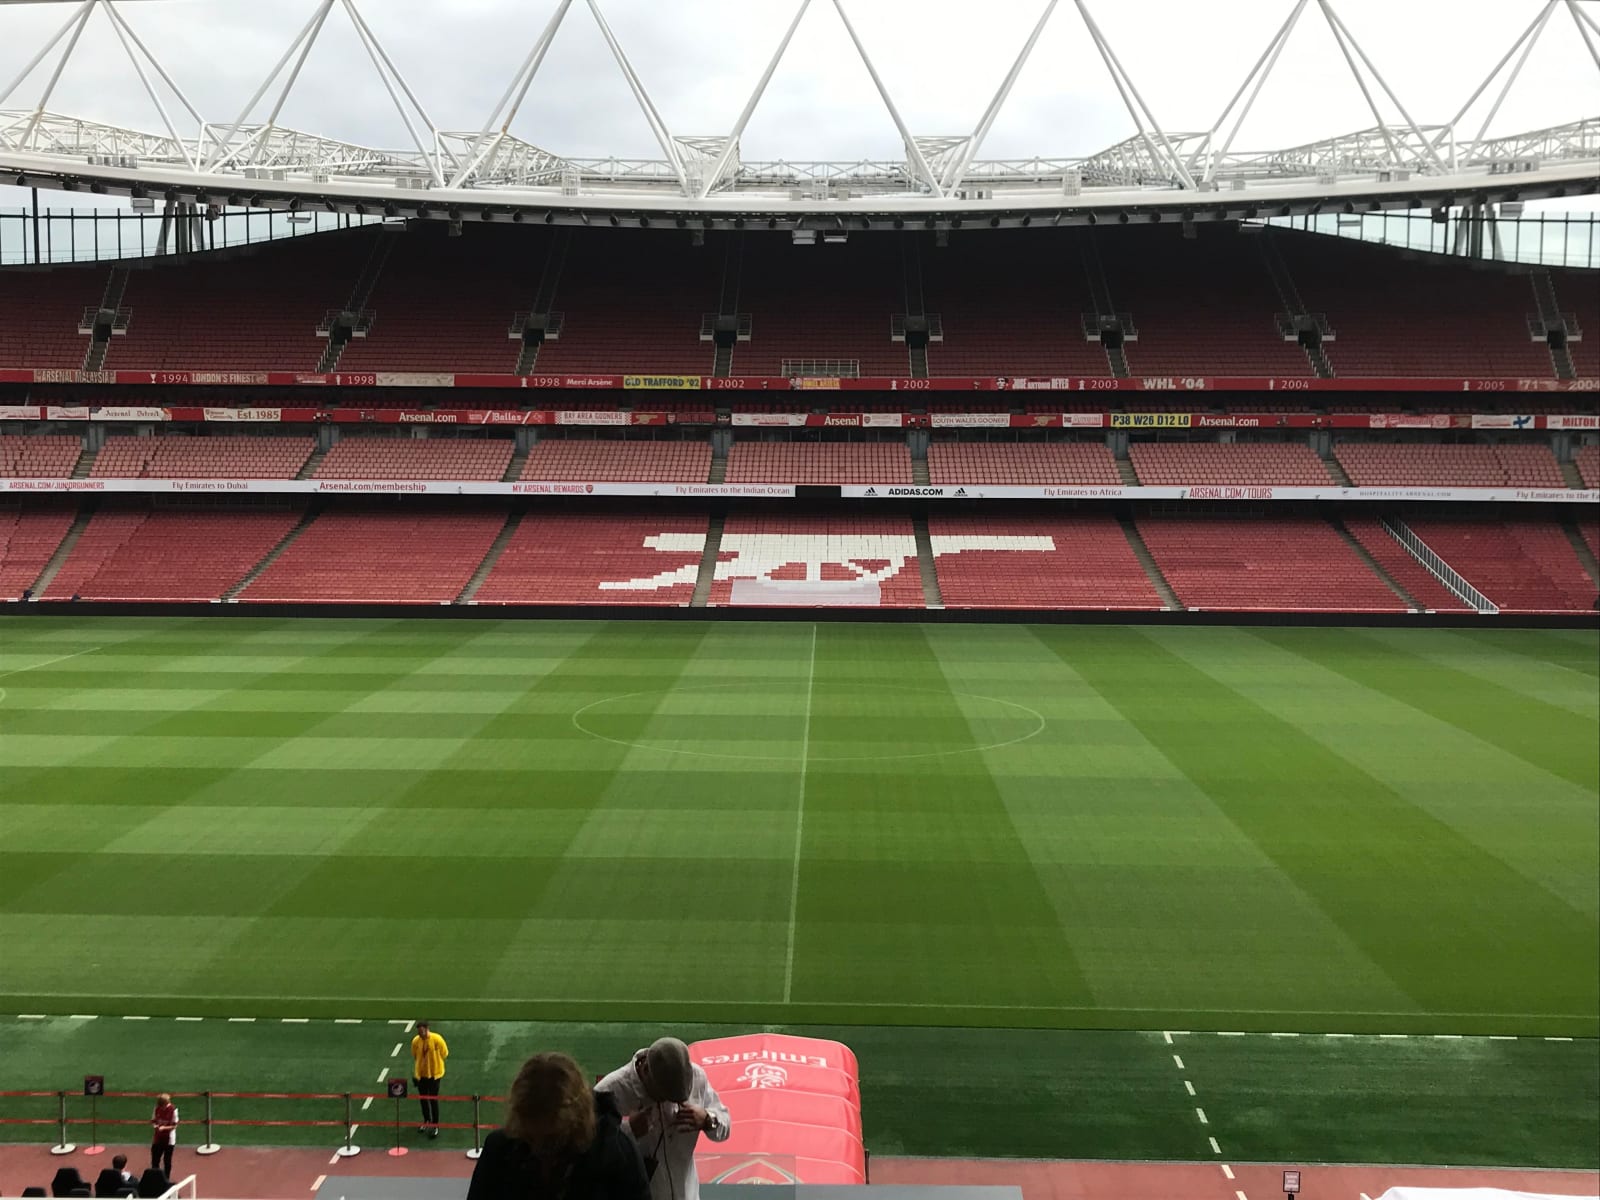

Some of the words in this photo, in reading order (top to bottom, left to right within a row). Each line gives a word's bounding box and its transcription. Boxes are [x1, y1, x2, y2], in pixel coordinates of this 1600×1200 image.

[42, 370, 73, 383] ARSENAL
[162, 374, 188, 383] 1994
[348, 375, 375, 385] 1998
[533, 378, 560, 387] 1998
[566, 378, 587, 386] Merci
[643, 379, 685, 387] TRAFFORD
[718, 379, 745, 388] 2002
[903, 380, 930, 389] 2002
[1091, 380, 1119, 389] 2003
[1143, 378, 1176, 390] WHL
[1180, 378, 1205, 389] '04
[1281, 380, 1309, 389] 2004
[1477, 381, 1505, 390] 2005
[256, 410, 280, 419] 1985
[399, 412, 457, 422] Arsenal.com
[824, 416, 860, 426] Arsenal
[1112, 415, 1131, 426] P38
[1133, 415, 1154, 426] W26
[1157, 416, 1176, 426] D12
[1199, 416, 1259, 426] Arsenal.com
[172, 482, 183, 490] Fly
[185, 482, 215, 490] Emirates
[227, 482, 248, 490] Dubai
[319, 482, 427, 492] Arsenal.com/membership
[512, 485, 522, 493] MY
[523, 485, 551, 493] ARSENAL
[553, 485, 584, 493] REWARDS
[676, 486, 687, 495] Fly
[689, 486, 719, 494] Emirates
[730, 486, 742, 494] the
[743, 486, 766, 494] Indian
[767, 486, 790, 494] Ocean
[888, 488, 943, 496] ADIDAS.COM
[1044, 488, 1056, 497] Fly
[1057, 488, 1087, 496] Emirates
[1099, 488, 1122, 496] Africa
[1189, 488, 1273, 499] ARSENAL.COM/TOURS
[702, 1050, 828, 1068] Emirates
